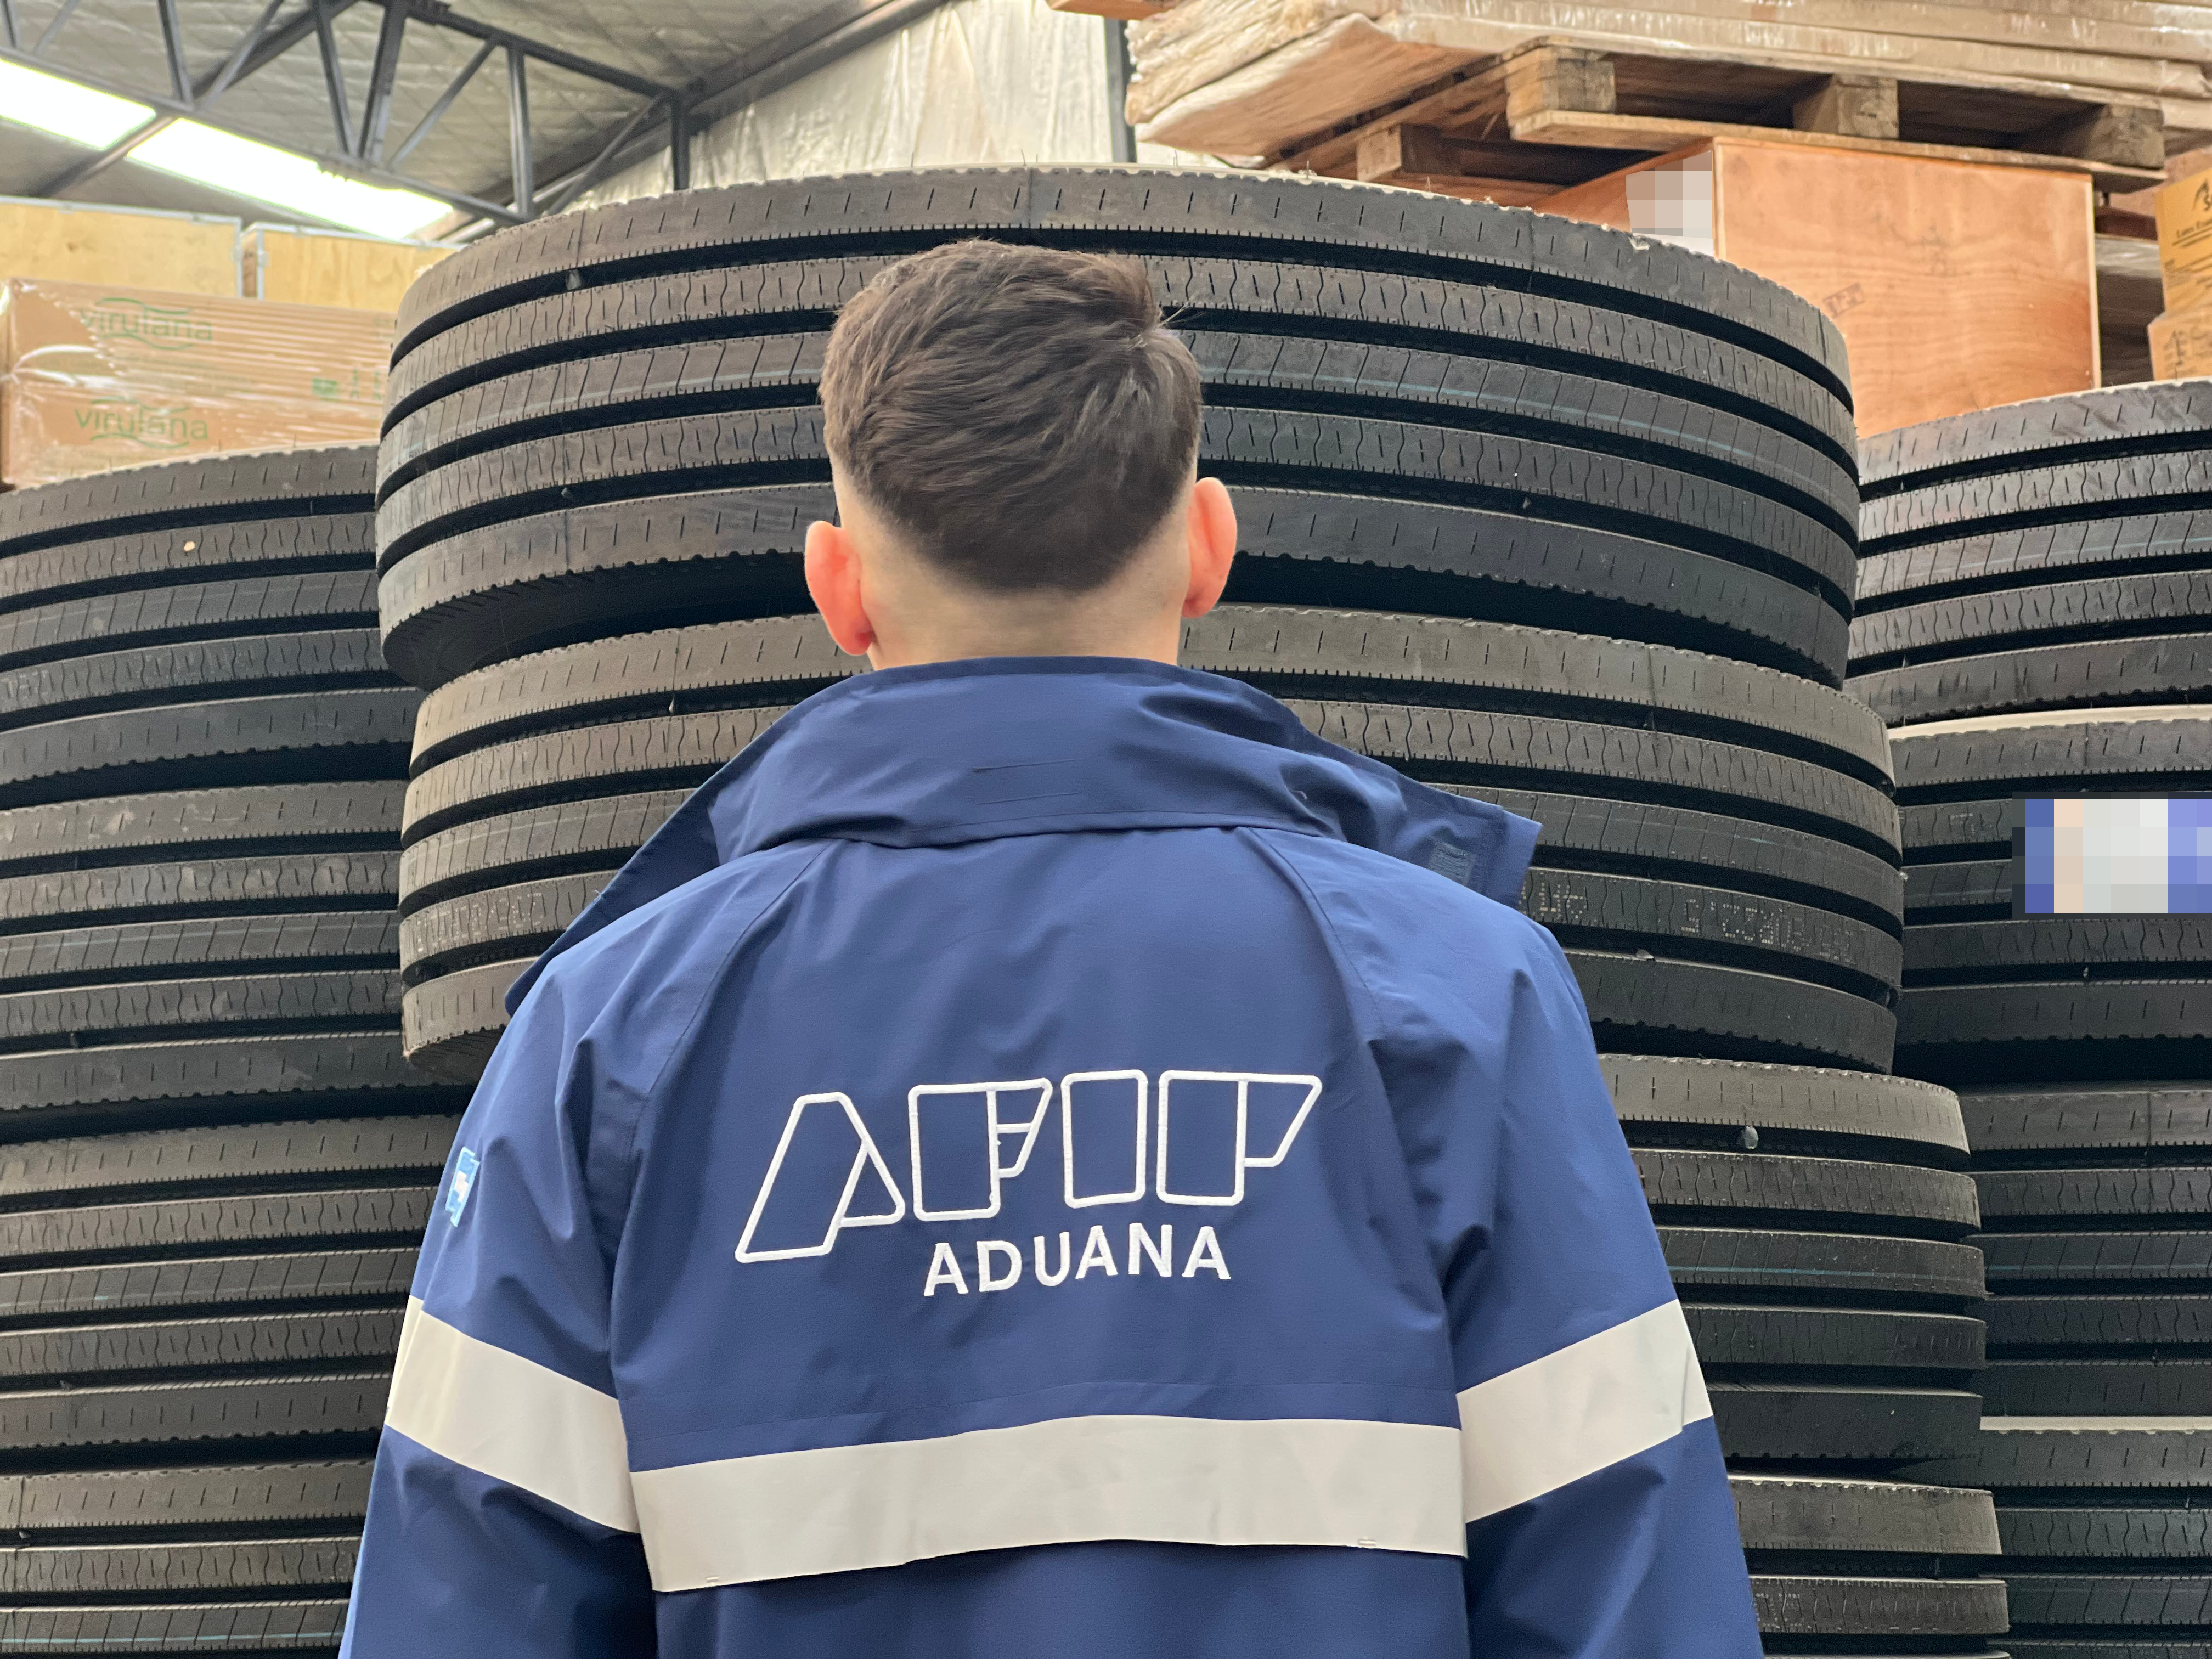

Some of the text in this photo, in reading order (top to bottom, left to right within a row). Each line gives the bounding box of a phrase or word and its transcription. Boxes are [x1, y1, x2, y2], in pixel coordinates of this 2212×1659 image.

[75, 408, 208, 440] virulana
[735, 1069, 1323, 1263] AFIP
[923, 1222, 1231, 1296] ADUANA
